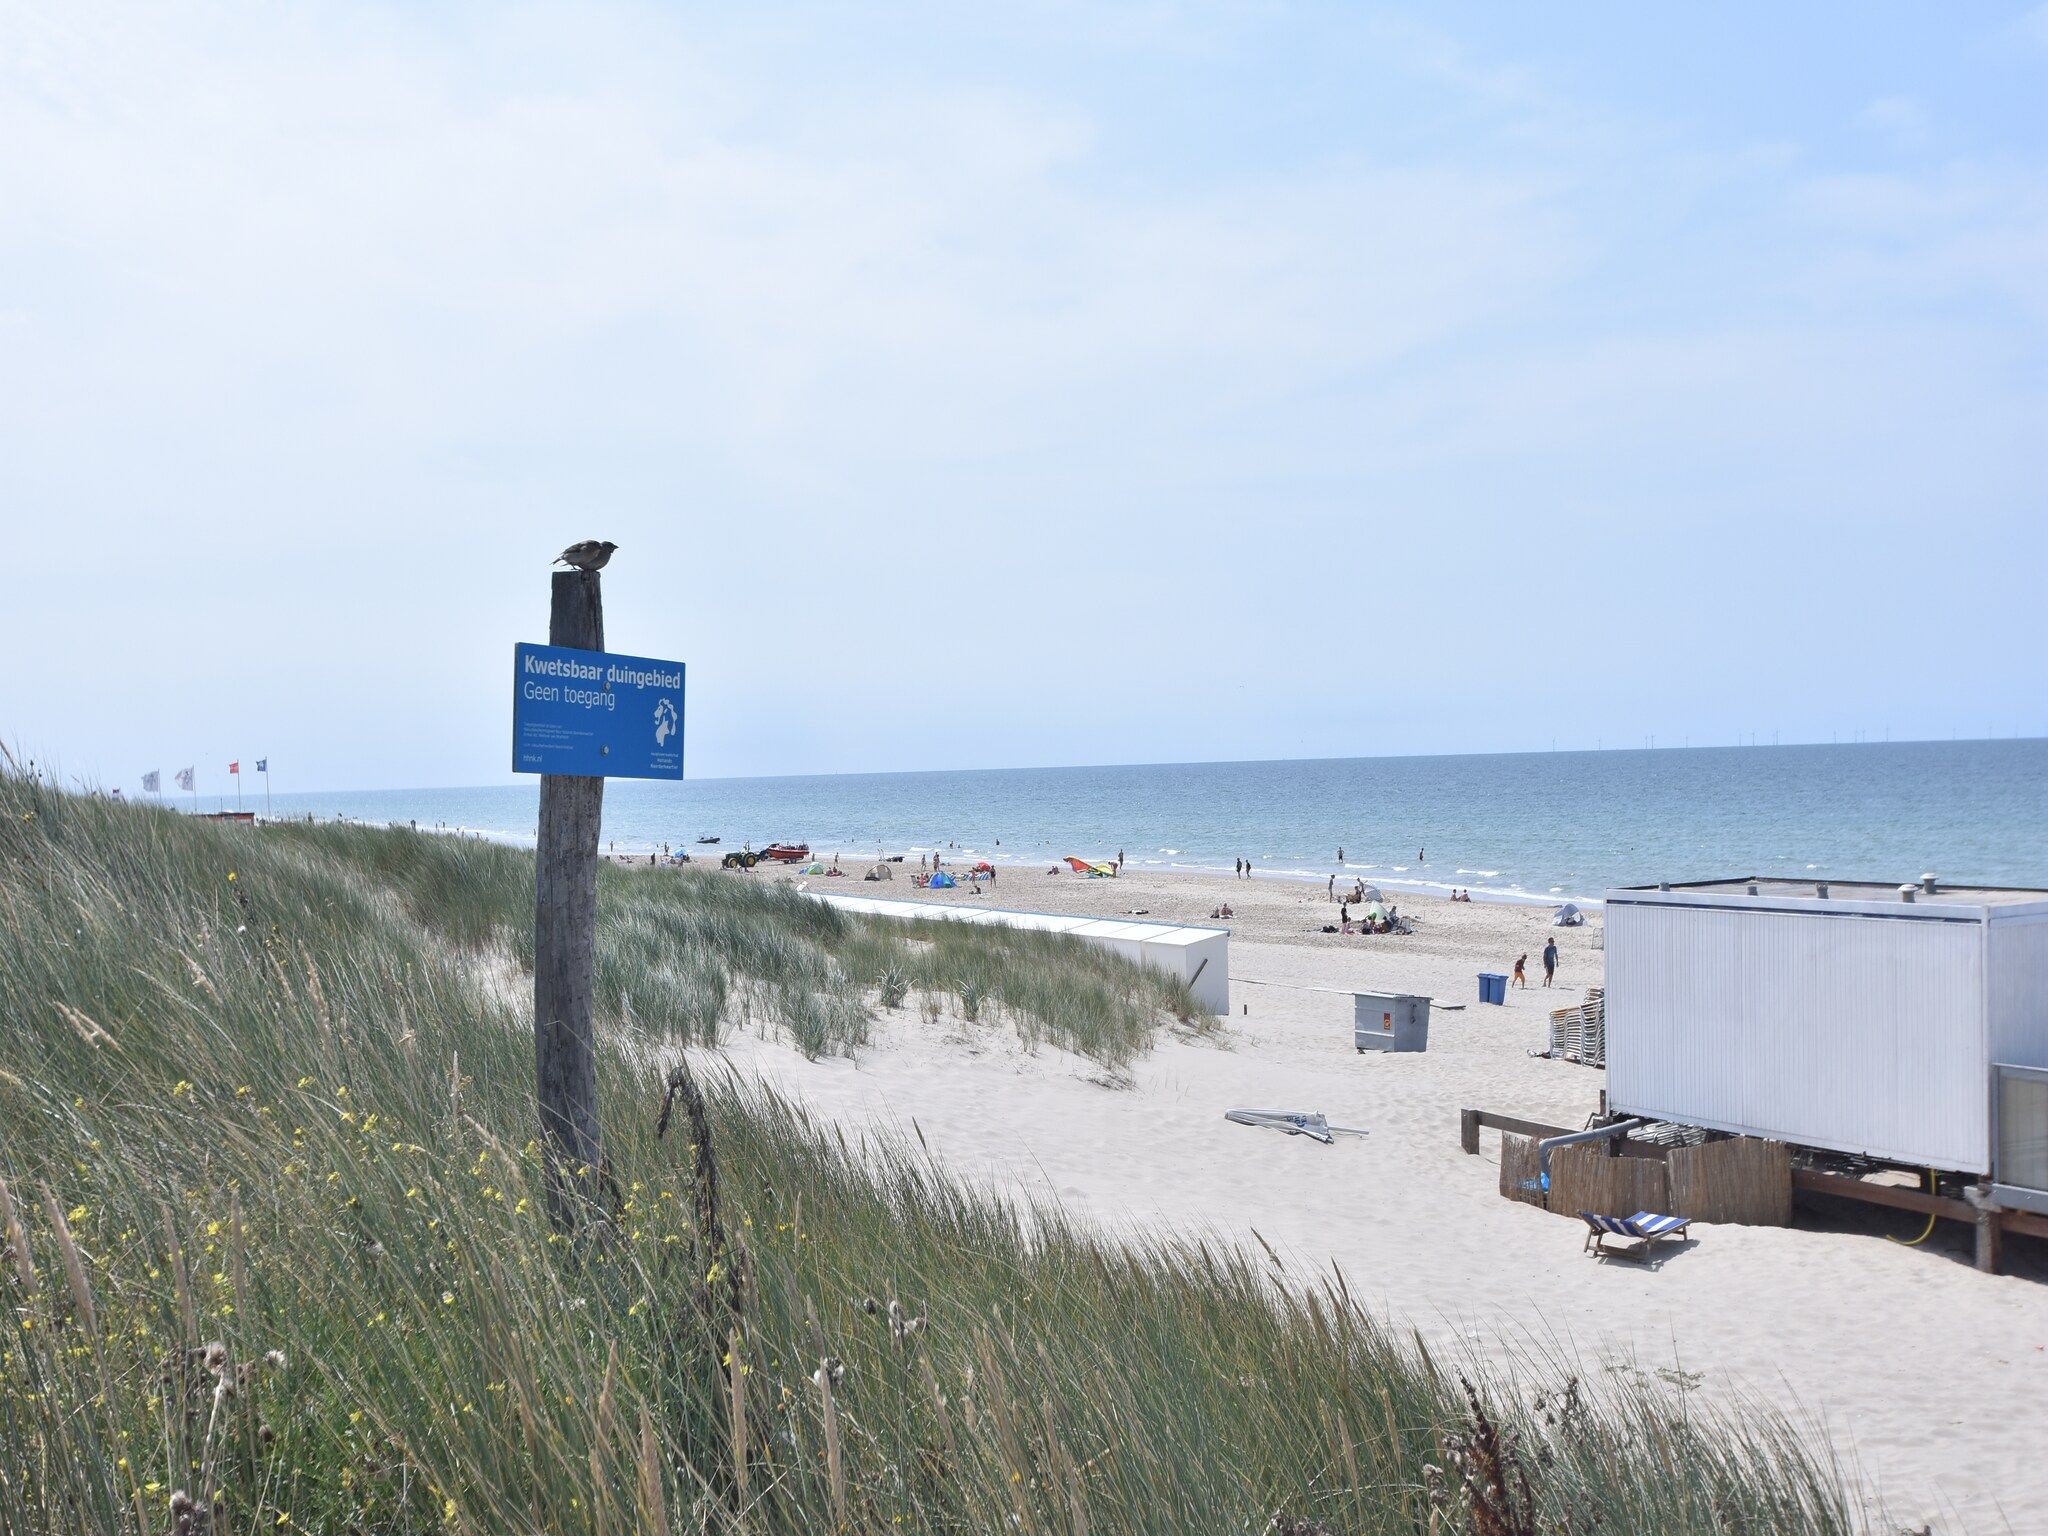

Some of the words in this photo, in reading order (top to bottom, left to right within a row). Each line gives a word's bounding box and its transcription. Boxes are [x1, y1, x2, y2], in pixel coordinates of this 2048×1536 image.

[525, 654, 603, 681] Kwetsbaar
[607, 665, 681, 689] duingebied
[524, 681, 559, 702] Geen
[564, 686, 616, 711] toegang
